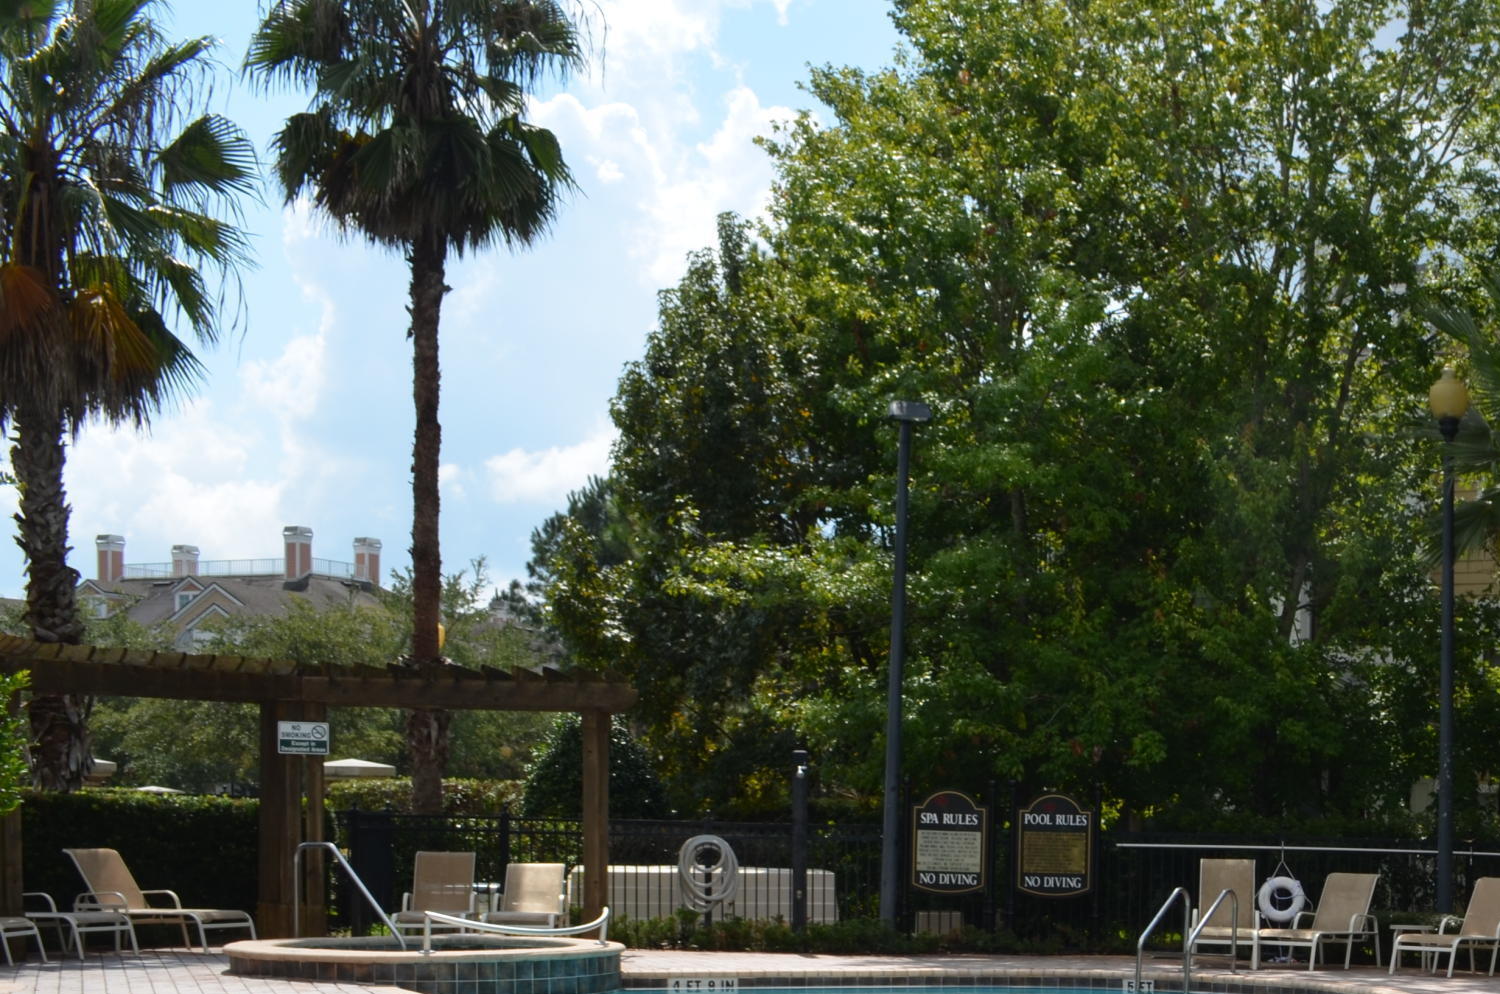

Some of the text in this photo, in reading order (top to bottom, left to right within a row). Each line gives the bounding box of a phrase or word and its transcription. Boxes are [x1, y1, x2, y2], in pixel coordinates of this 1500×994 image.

[281, 731, 311, 739] SMOKING
[920, 812, 978, 825] SPA RULES
[1024, 813, 1087, 826] POOL RULES
[919, 873, 978, 886] NO DIVING
[1024, 876, 1082, 888] NO DIVING
